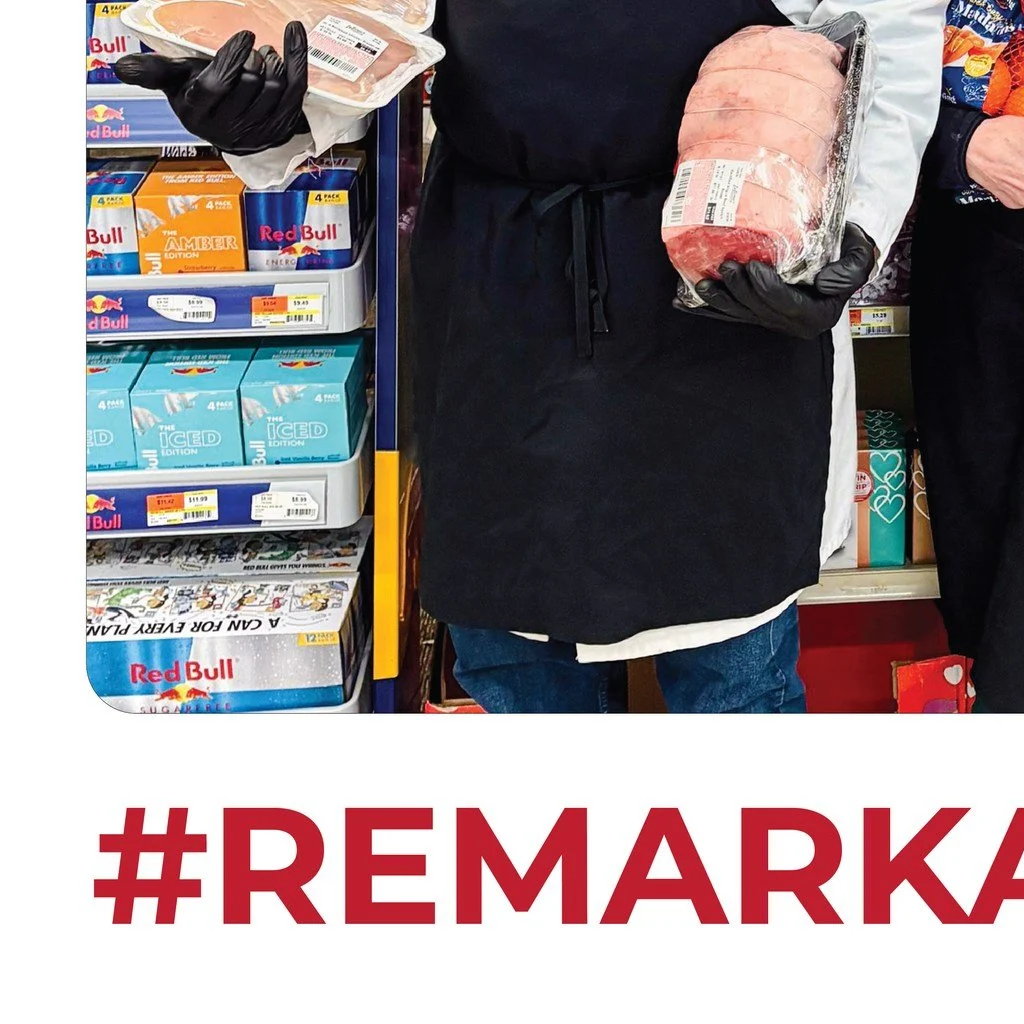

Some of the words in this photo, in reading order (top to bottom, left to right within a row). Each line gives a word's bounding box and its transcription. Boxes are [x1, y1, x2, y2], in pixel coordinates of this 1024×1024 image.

[101, 5, 109, 14] 4
[90, 36, 127, 54] Bull
[101, 125, 130, 139] Bull
[98, 198, 105, 206] 4
[315, 194, 322, 202] 4
[205, 201, 214, 210] 4
[87, 227, 123, 244] Bull
[259, 224, 297, 242] Red
[301, 223, 336, 241] Bull
[164, 235, 238, 252] AMBER
[101, 315, 128, 329] Bull
[315, 394, 323, 402] 4
[98, 401, 106, 409] 4
[207, 401, 216, 410] 4
[267, 422, 328, 439] ICED
[160, 430, 221, 448] ICED
[95, 514, 121, 529] Bull
[136, 622, 185, 634] EVERY
[192, 620, 221, 632] FOR
[230, 618, 263, 630] CAN
[269, 617, 280, 628] A
[305, 634, 316, 642] 12
[131, 661, 179, 684] Red
[185, 659, 234, 682] Bull
[140, 703, 230, 713] SUGARFREE
